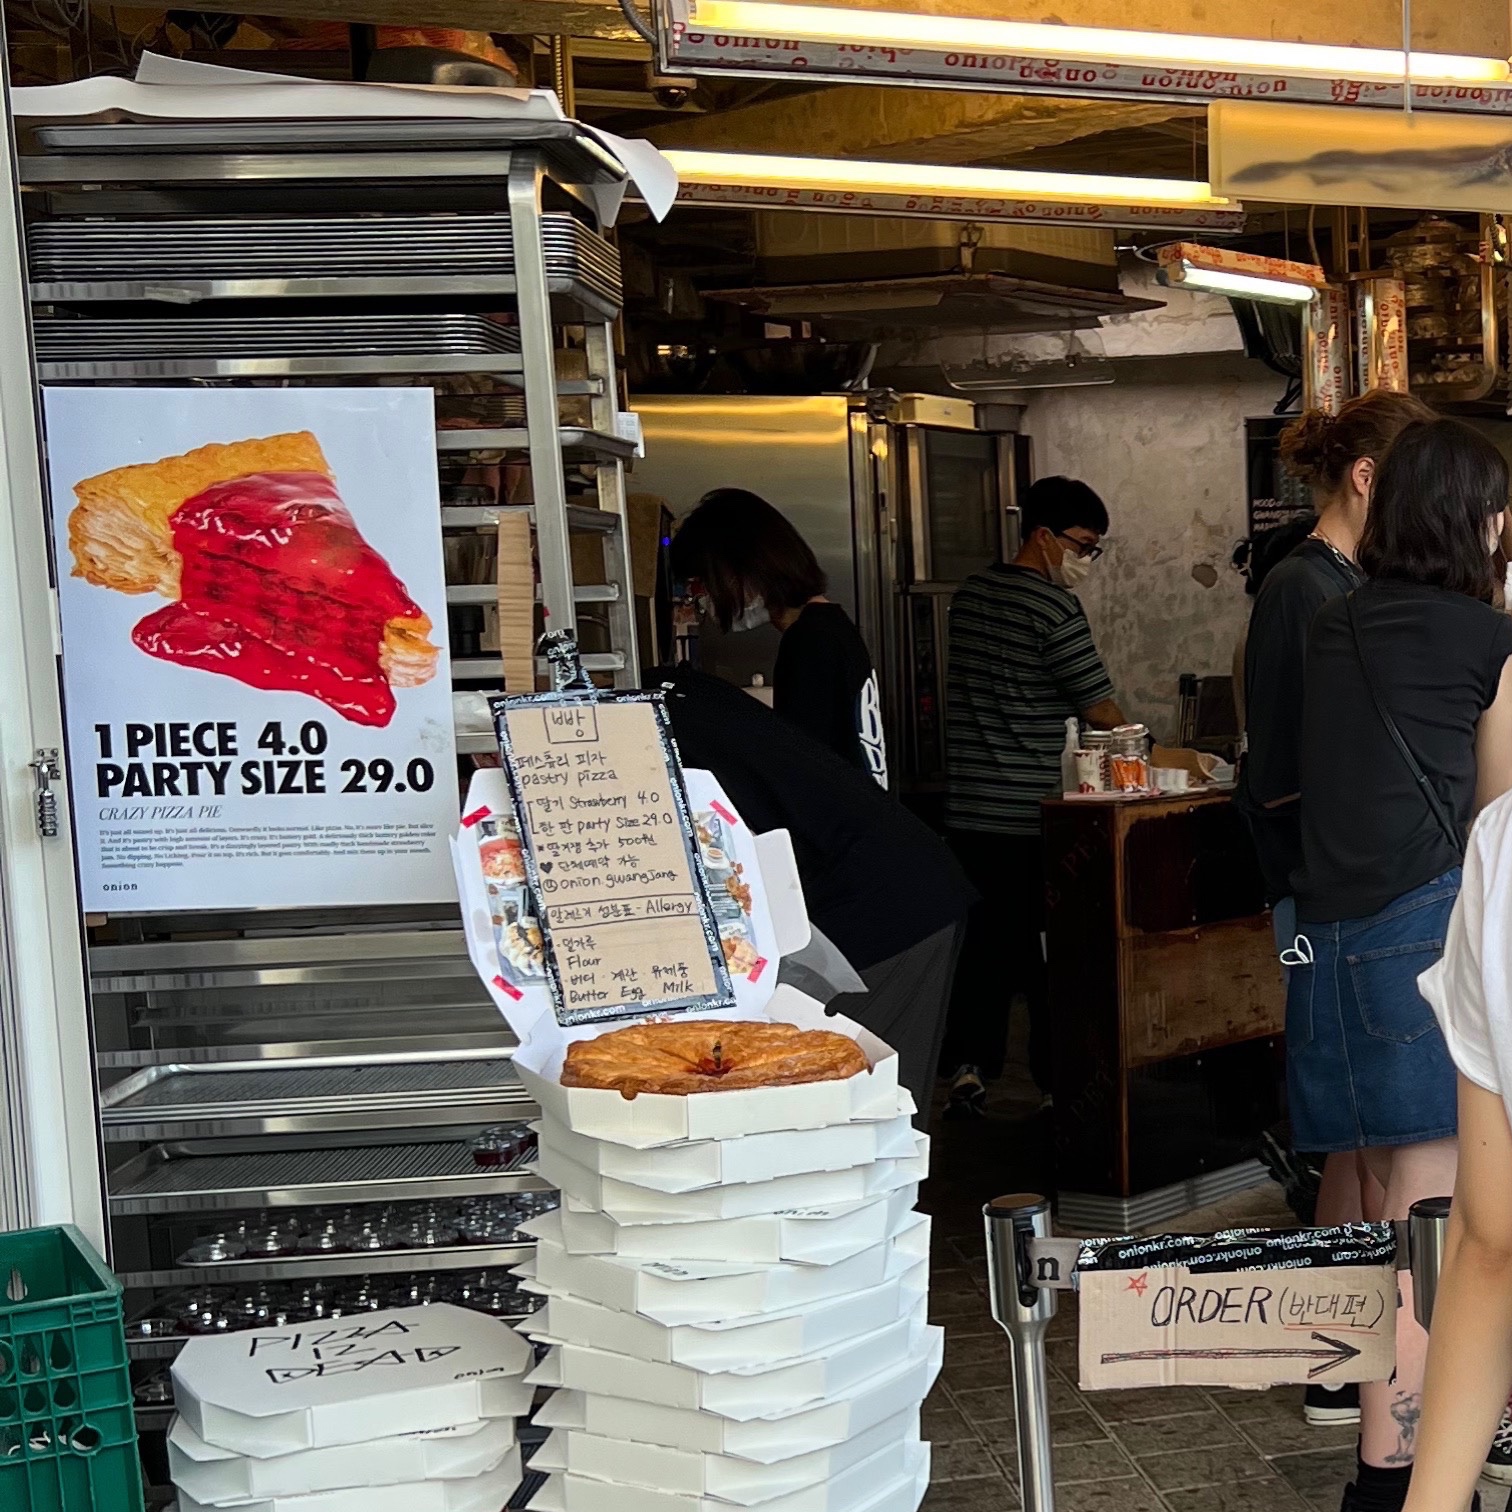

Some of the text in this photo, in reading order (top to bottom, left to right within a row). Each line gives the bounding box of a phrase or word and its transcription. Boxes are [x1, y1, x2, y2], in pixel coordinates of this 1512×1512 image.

[551, 709, 586, 738] 빵
[95, 720, 328, 759] 1 PIECE 4.0
[576, 750, 607, 767] 피자
[96, 757, 435, 798] PARTY SIZE 29.0
[521, 768, 618, 789] pastry pizza
[99, 805, 223, 820] CRAZY PIZZA PIE
[536, 797, 564, 813] 딸기
[539, 819, 554, 836] 한
[560, 818, 573, 834] 판
[577, 816, 611, 834] party
[103, 880, 138, 891] onion
[646, 899, 693, 917] Allergy
[567, 955, 602, 971] Flour
[569, 988, 609, 1004] Butter
[620, 986, 647, 1001] Egg
[662, 980, 694, 995] Milk
[1118, 1234, 1195, 1259] onionkr.com
[1265, 1225, 1342, 1247] onionkr.com
[1151, 1286, 1273, 1328] ORDER
[250, 1320, 420, 1357] PIZZA
